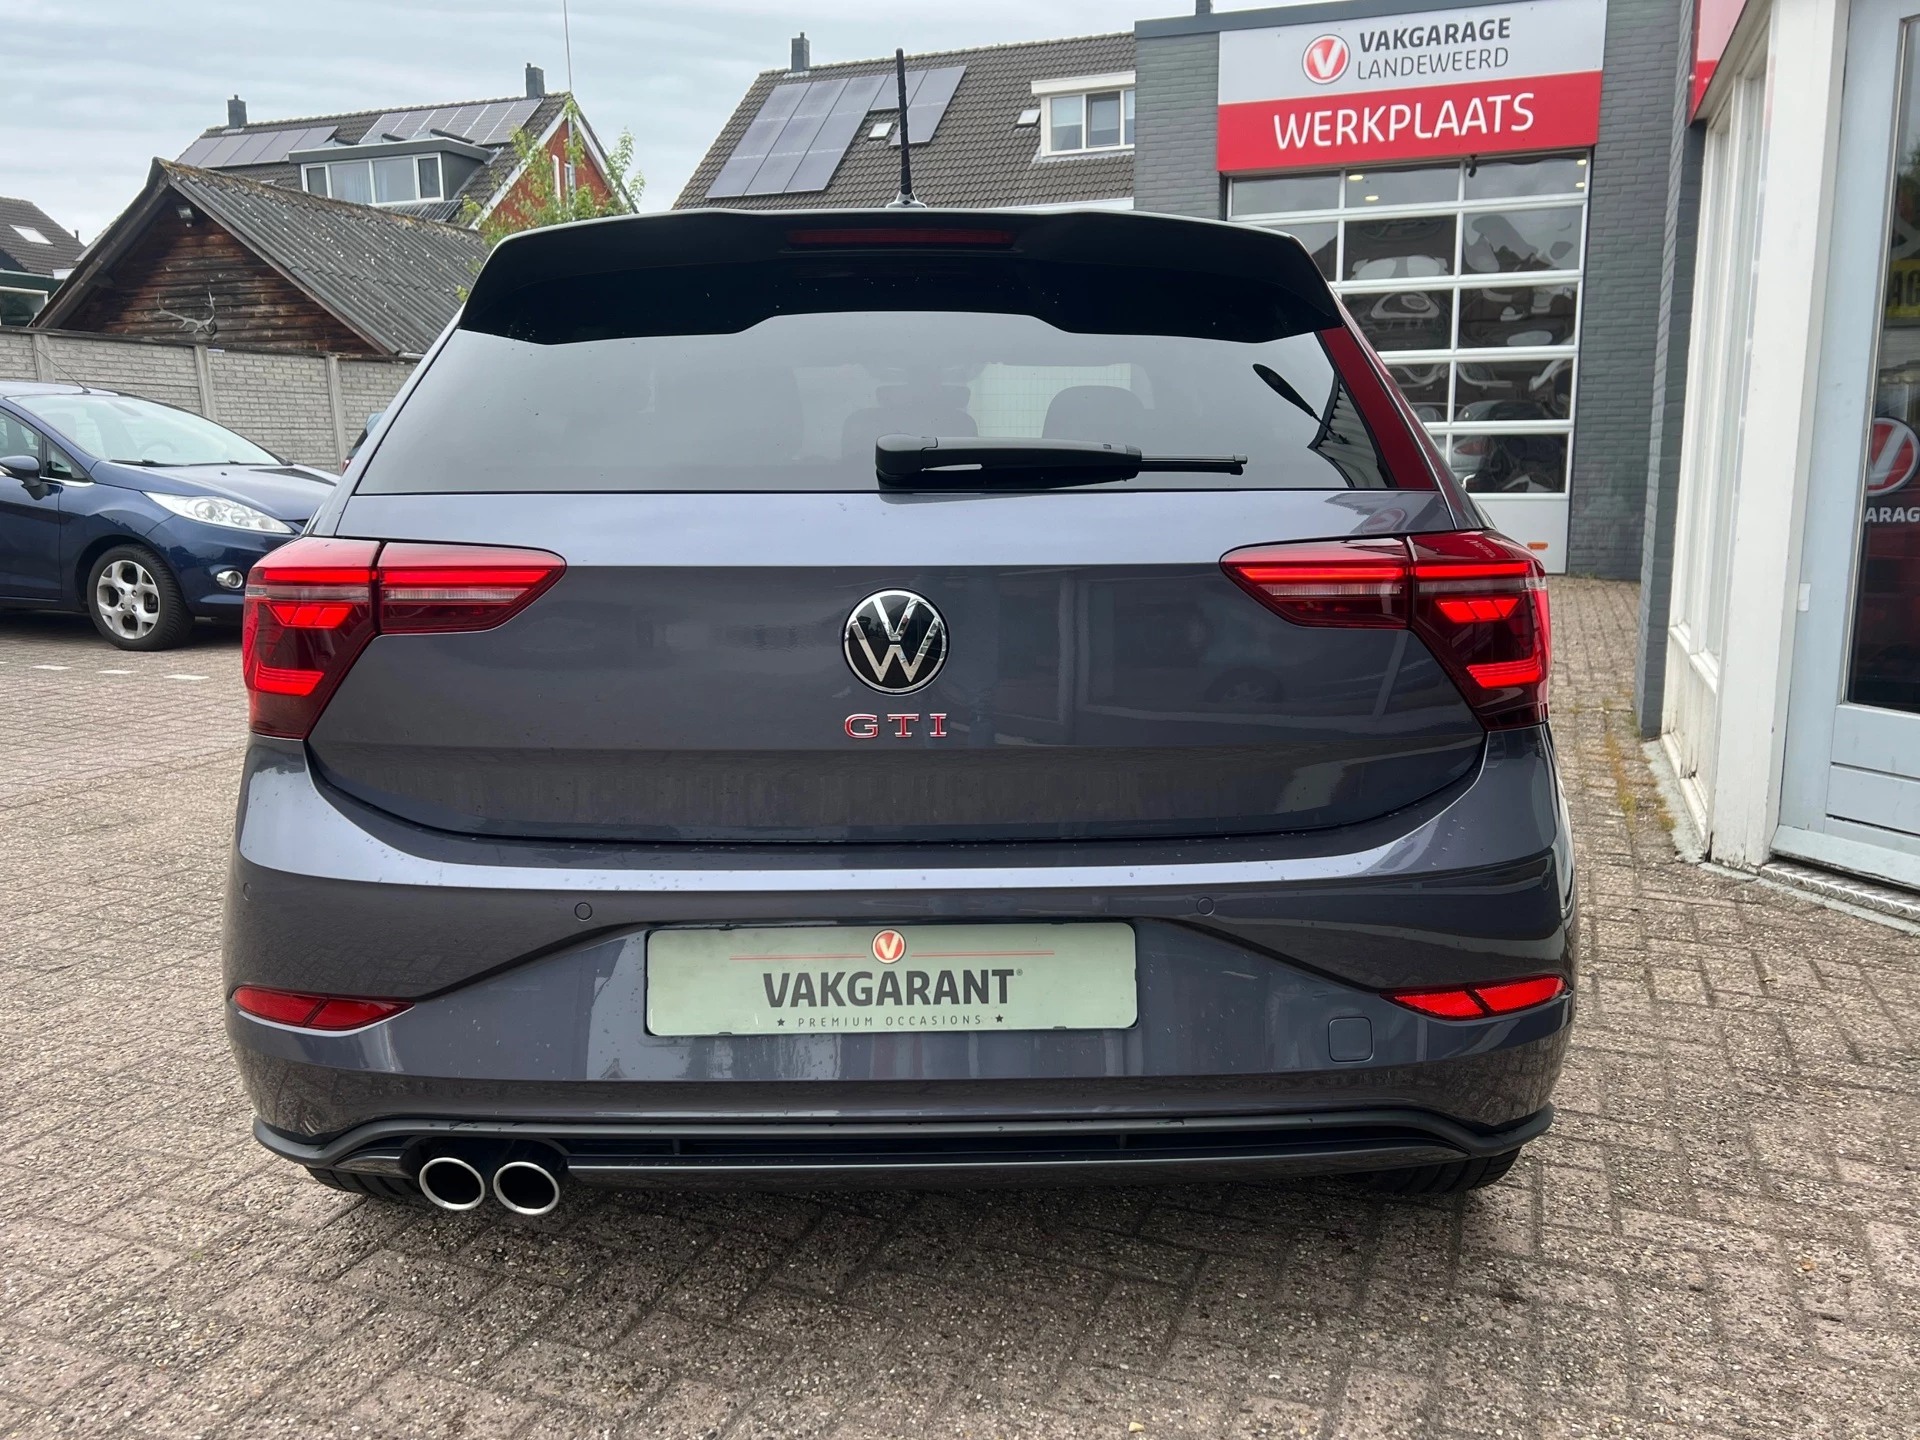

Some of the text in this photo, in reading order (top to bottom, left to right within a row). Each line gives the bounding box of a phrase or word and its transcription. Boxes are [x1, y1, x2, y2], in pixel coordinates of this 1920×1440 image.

[1360, 17, 1512, 53] VAKGARAGE
[1357, 47, 1509, 80] LANDEWEERD
[1273, 92, 1535, 151] WERKPLAATS
[844, 713, 948, 739] GTI
[798, 1014, 982, 1027] PREMIUM OCCASIONS
